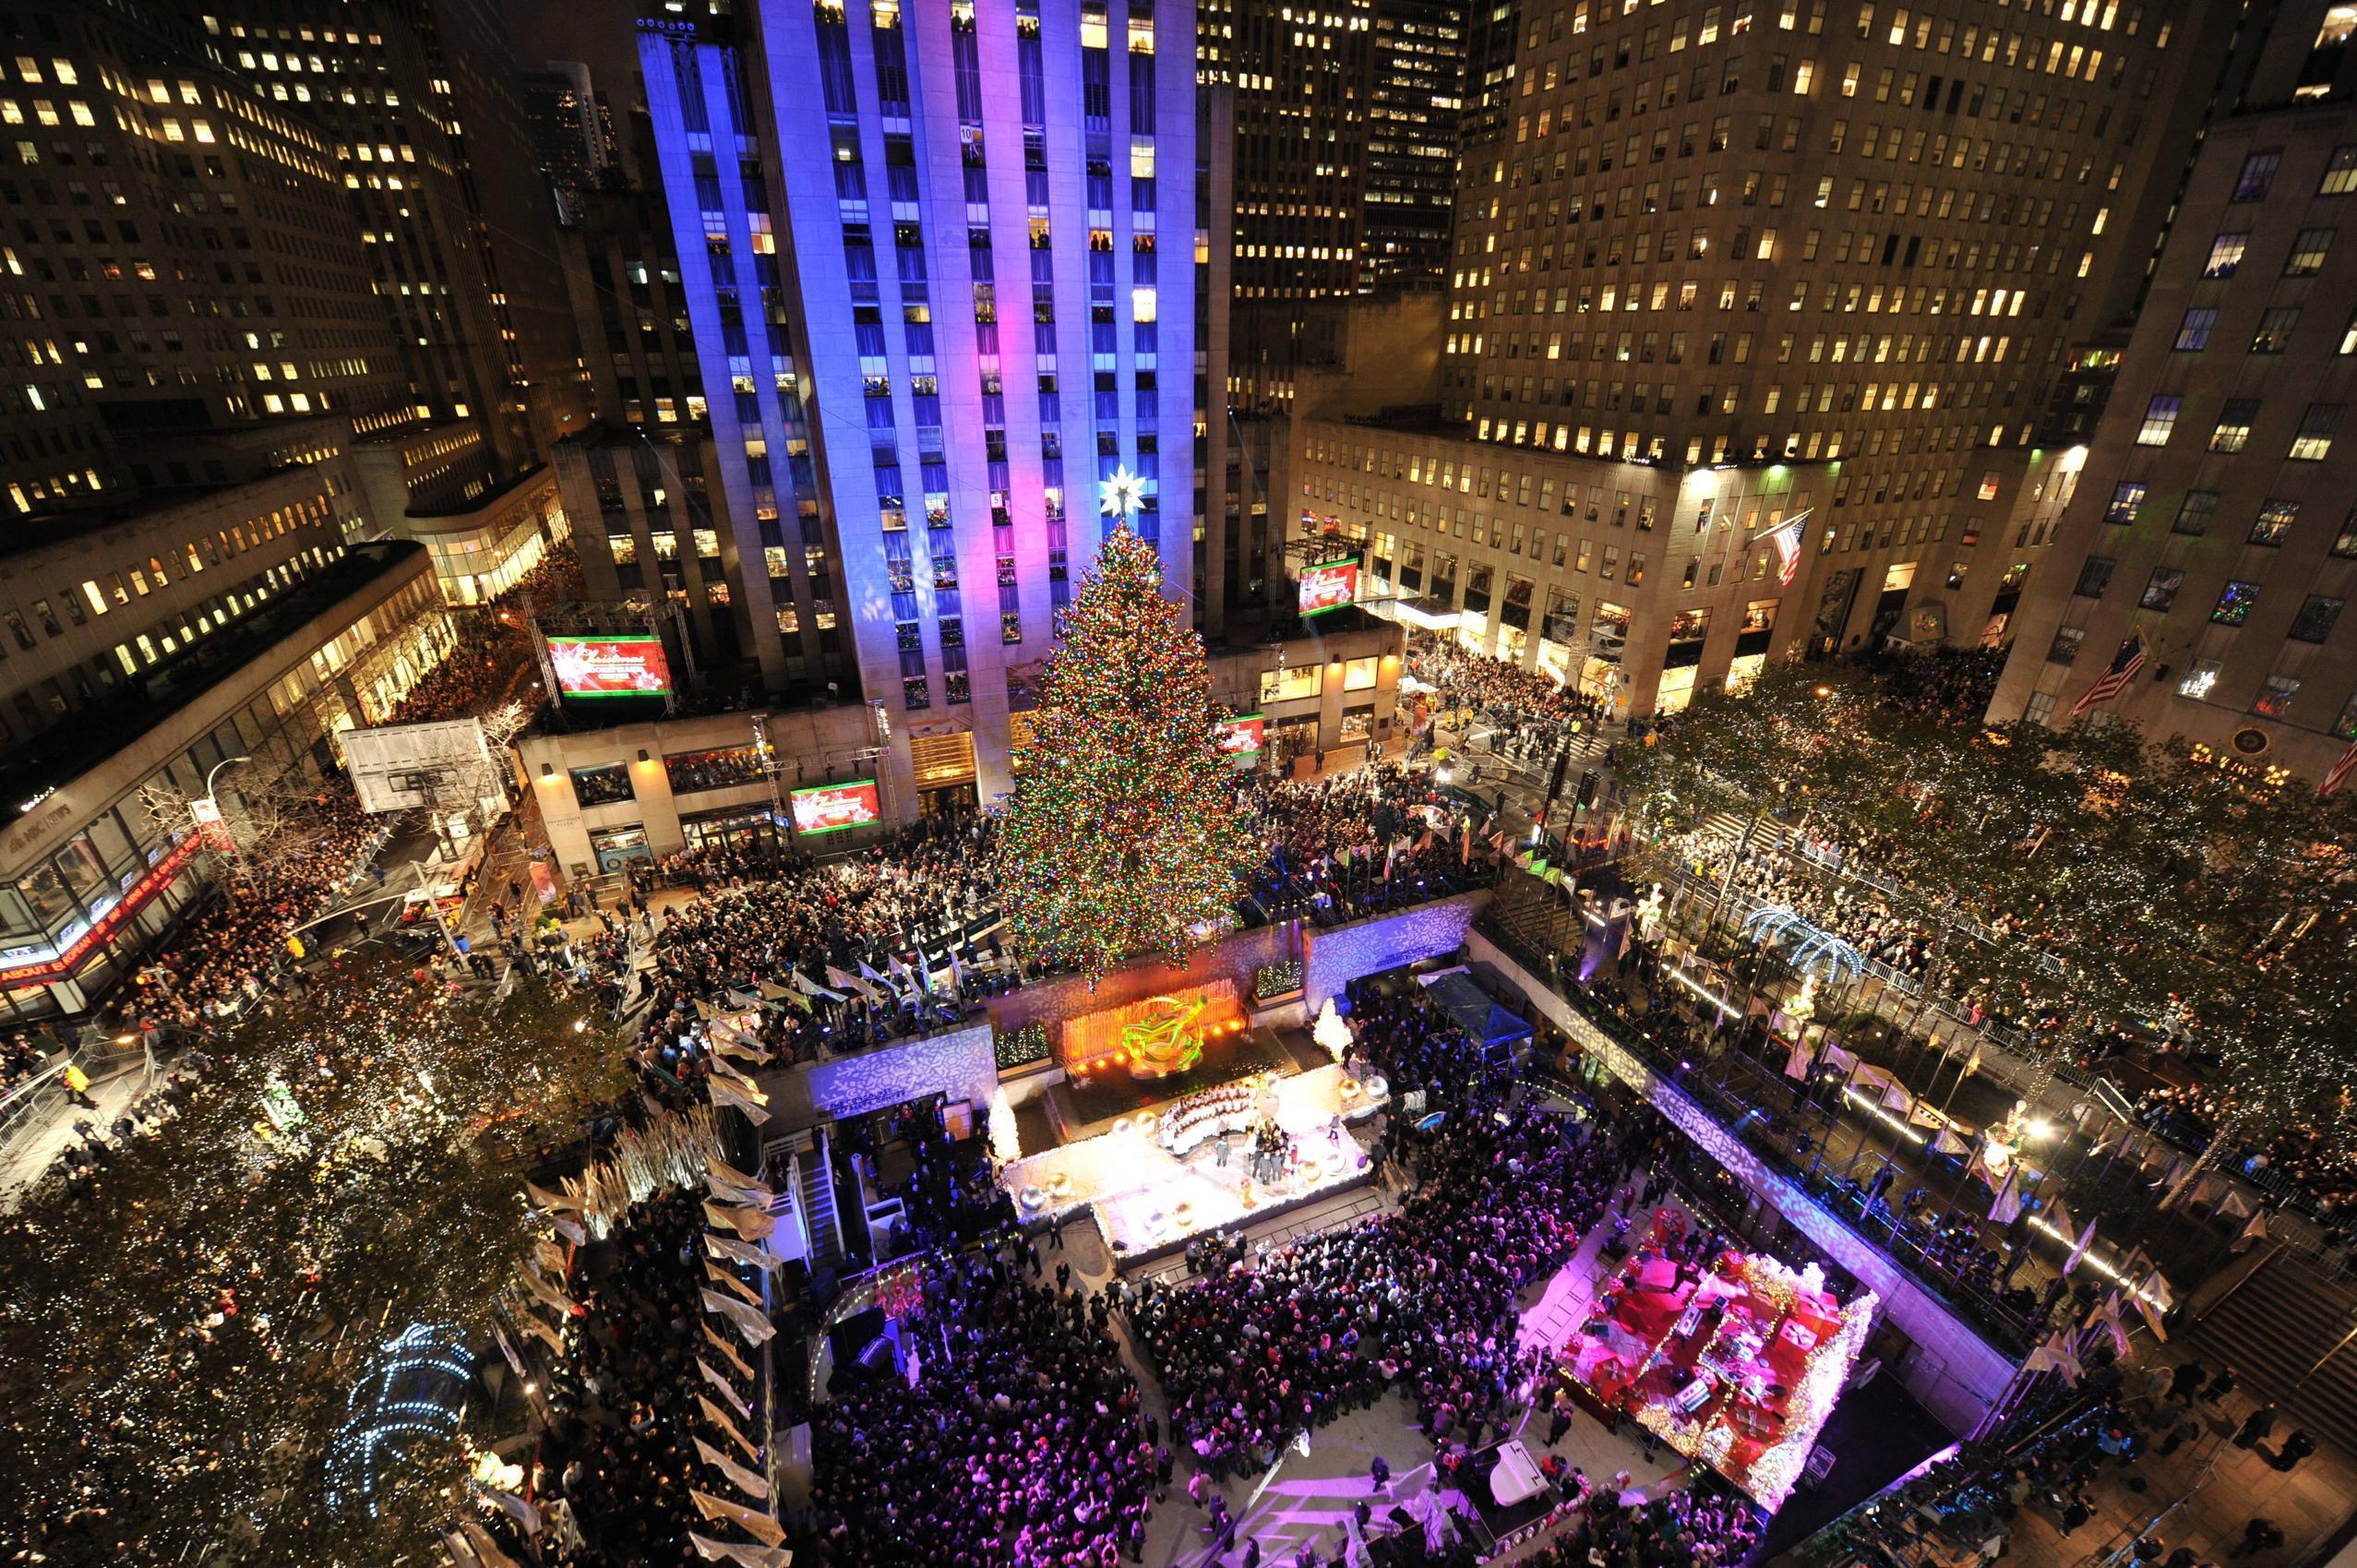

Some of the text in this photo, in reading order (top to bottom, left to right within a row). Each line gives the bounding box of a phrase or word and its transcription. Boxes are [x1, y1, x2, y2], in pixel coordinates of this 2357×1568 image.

[961, 128, 972, 139] 10
[577, 648, 645, 664] Christmas
[23, 820, 46, 843] NBC
[1, 964, 49, 980] ABOUT
